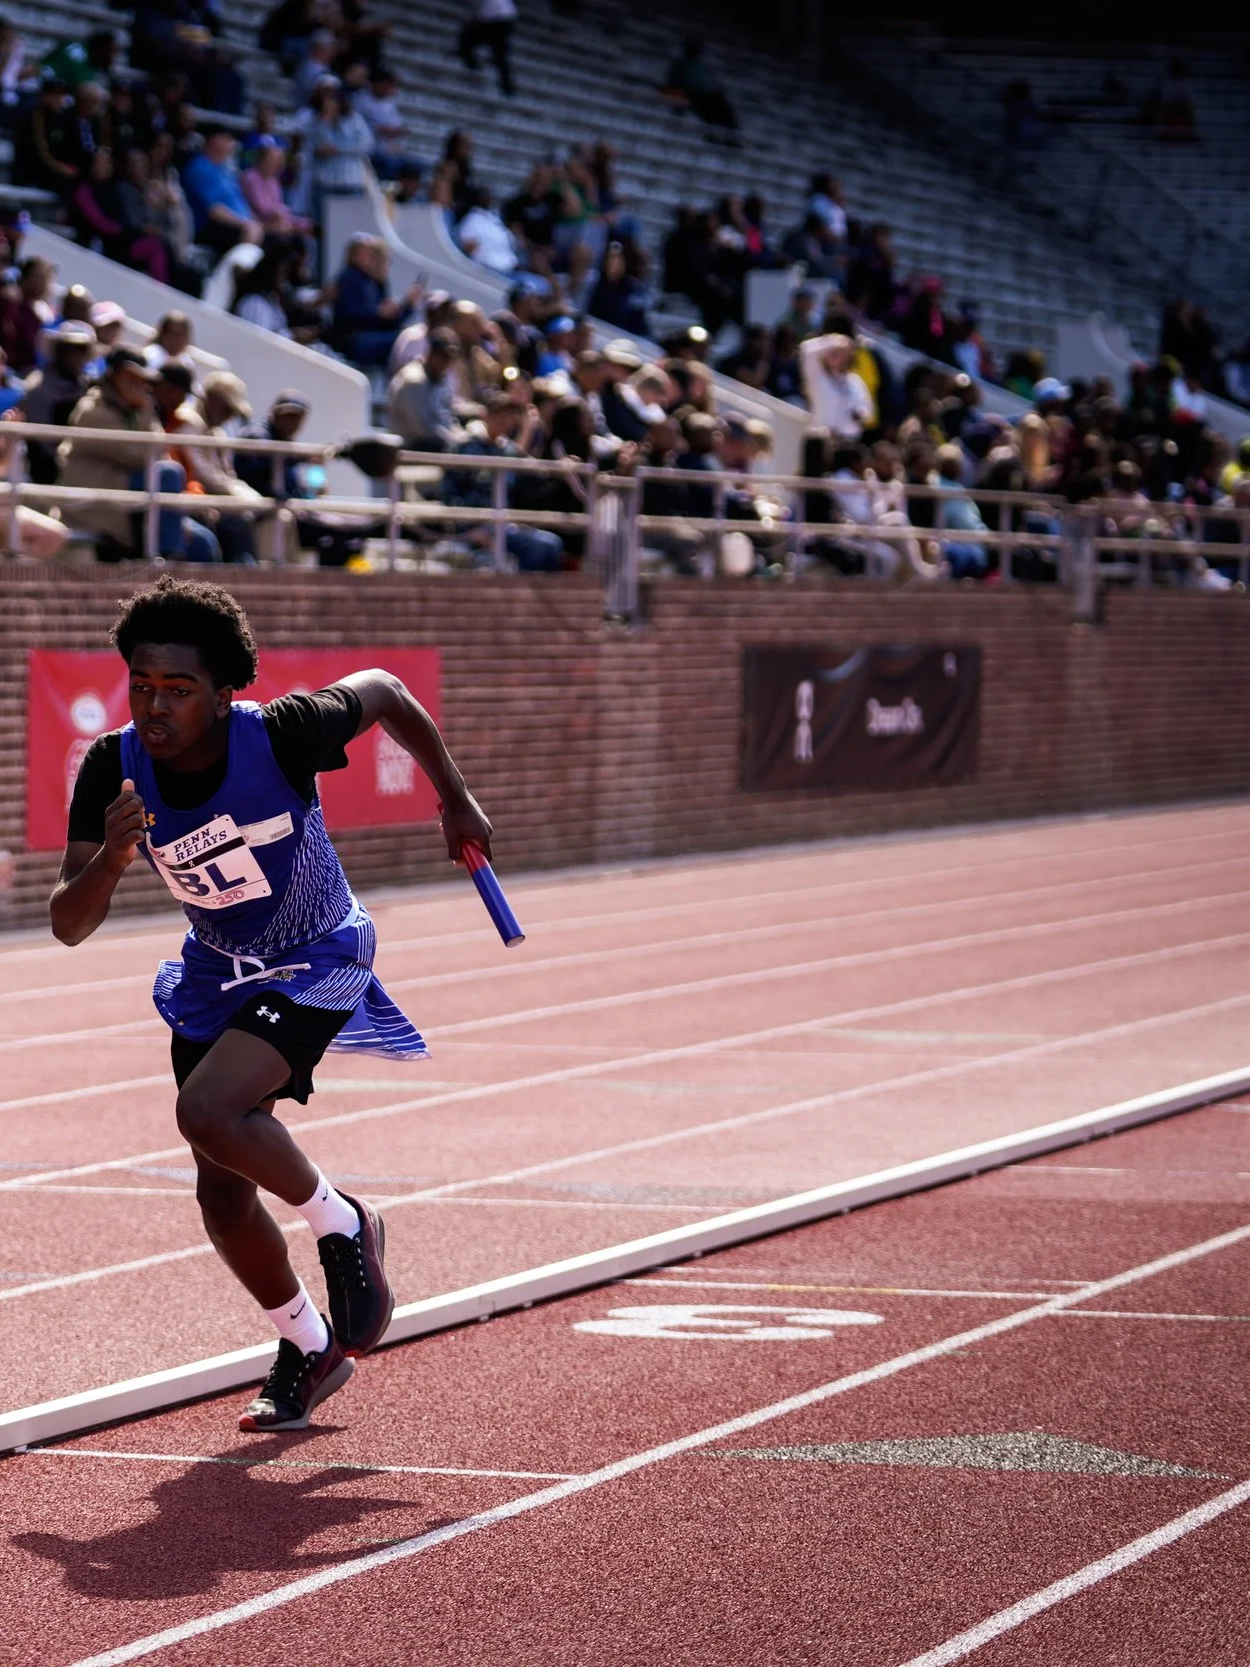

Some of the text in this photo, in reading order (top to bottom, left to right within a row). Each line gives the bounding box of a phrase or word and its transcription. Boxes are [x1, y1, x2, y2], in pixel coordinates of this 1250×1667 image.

[174, 827, 211, 854] PENN
[175, 830, 228, 862] RELAYS
[169, 862, 247, 897] BL
[216, 889, 246, 906] 250
